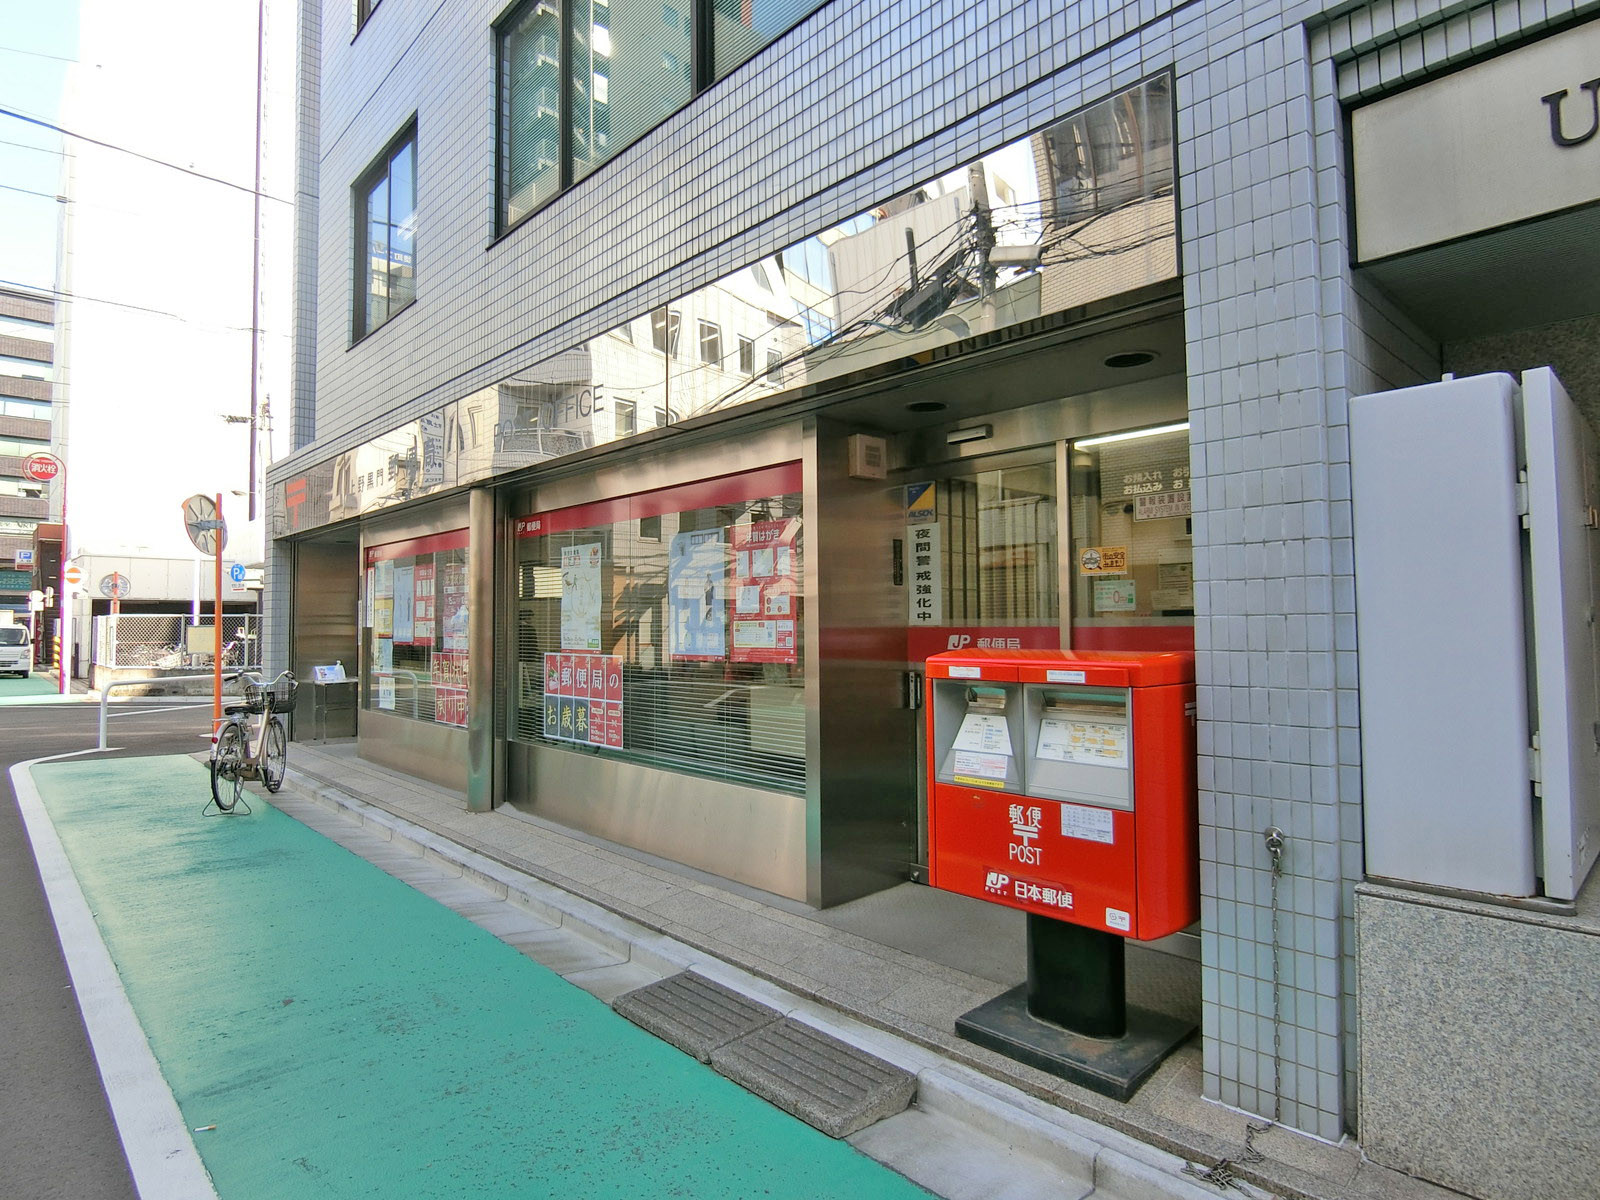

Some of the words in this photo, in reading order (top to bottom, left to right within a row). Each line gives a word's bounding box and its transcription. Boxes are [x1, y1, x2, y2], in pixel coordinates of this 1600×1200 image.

[1541, 77, 1600, 148] U
[542, 383, 605, 430] OFFICE
[32, 463, 57, 474] 消火栓
[1123, 482, 1163, 494] お払込み
[915, 528, 932, 622] 夜間警戒強化中
[977, 637, 1020, 649] 郵便局
[561, 667, 619, 690] 郵便局の
[547, 705, 588, 732] お歳暮
[1008, 803, 1042, 828] 郵便
[1008, 843, 1042, 866] POST
[984, 886, 1008, 896] POST
[1014, 880, 1073, 909] 日本郵便
